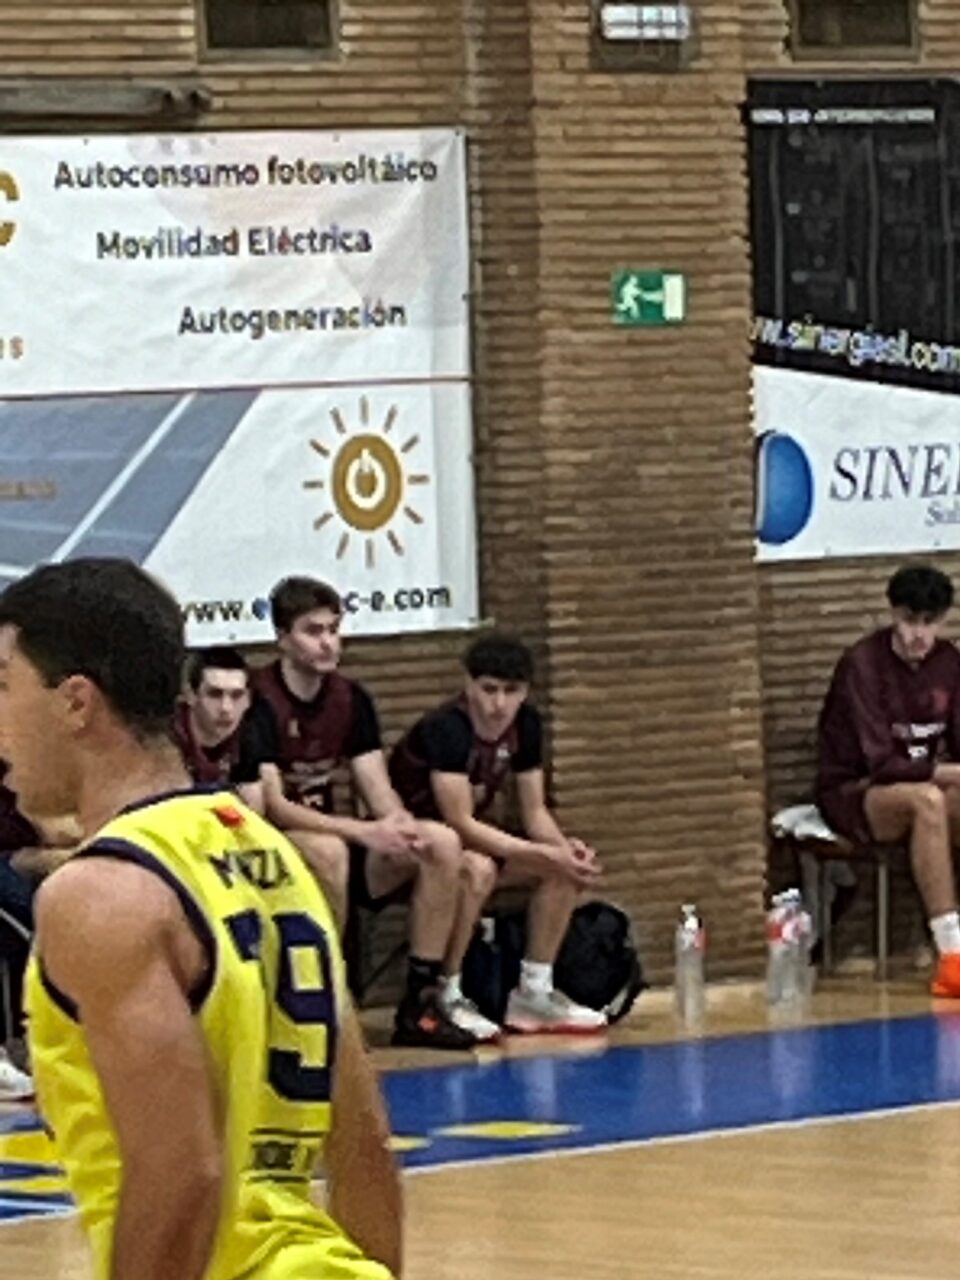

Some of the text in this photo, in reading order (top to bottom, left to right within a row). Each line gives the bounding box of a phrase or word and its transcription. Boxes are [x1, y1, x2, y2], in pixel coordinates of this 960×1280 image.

[54, 154, 438, 189] Autoconsumo fotovoltáico
[96, 223, 372, 260] Movilidad Eléctrica
[178, 301, 406, 339] Autogeneración
